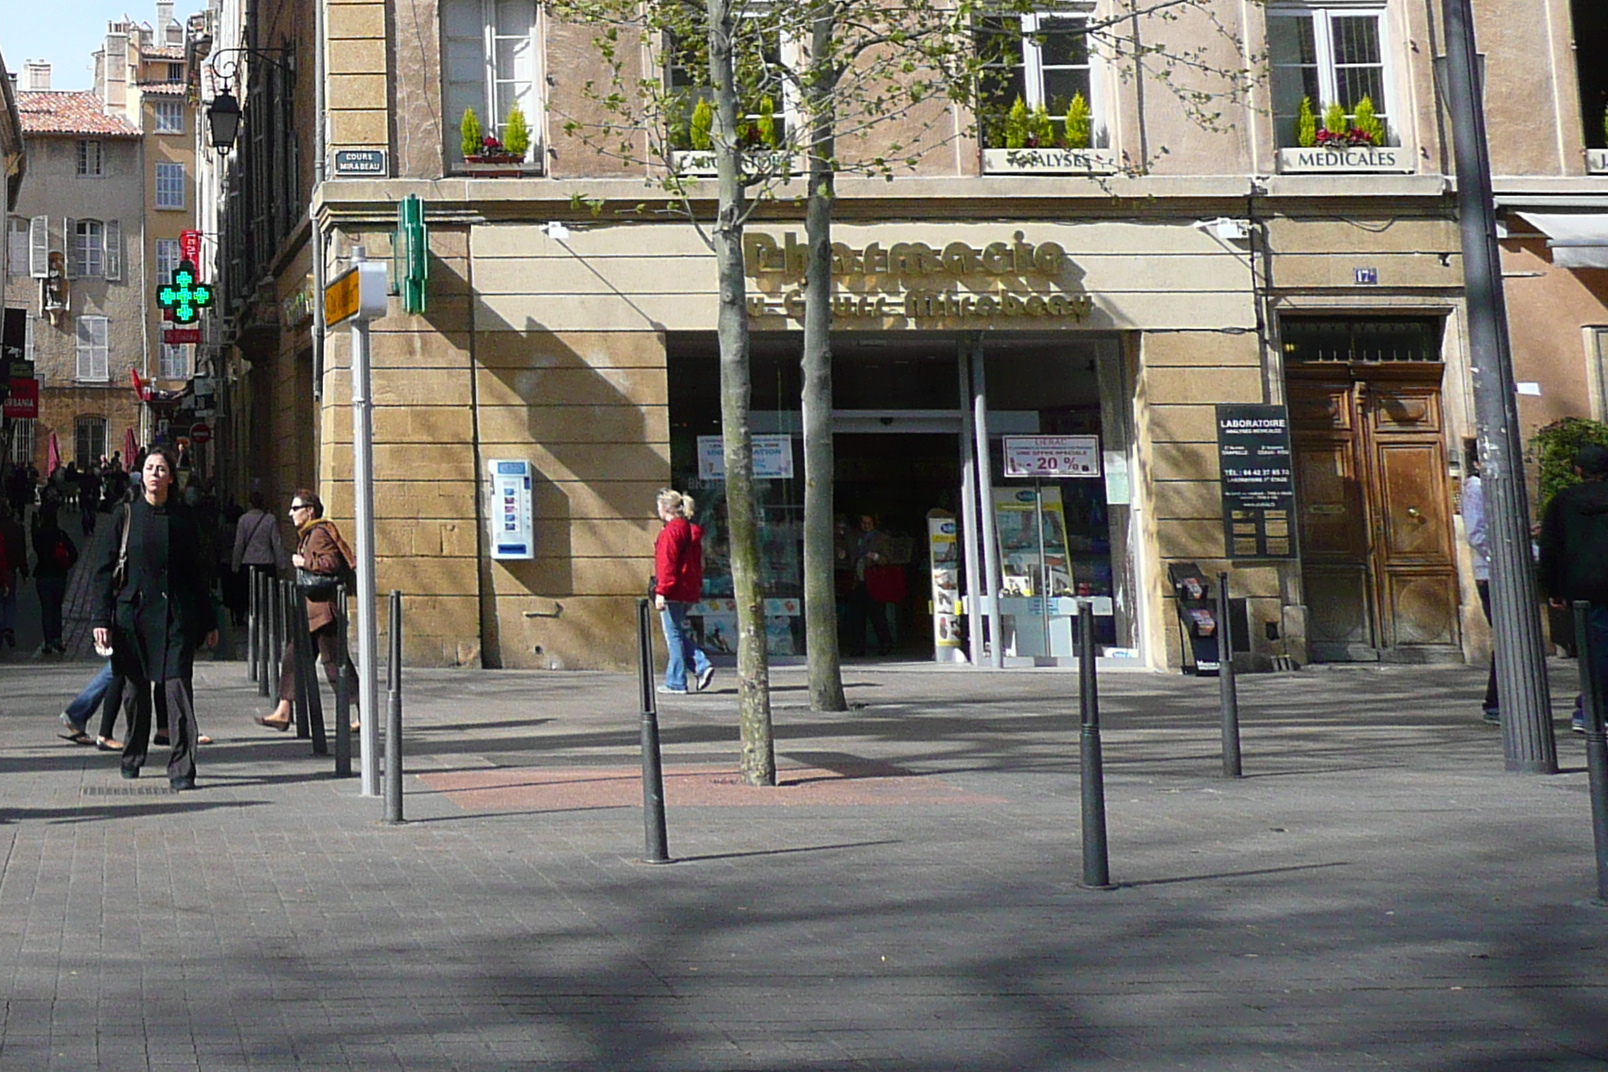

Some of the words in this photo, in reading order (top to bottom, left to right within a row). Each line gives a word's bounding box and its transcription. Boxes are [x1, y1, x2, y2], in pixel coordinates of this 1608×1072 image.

[345, 153, 374, 161] COURS
[1298, 152, 1396, 167] MEDICALES
[783, 288, 889, 318] Curs
[1220, 419, 1286, 428] LABORATOIRE
[1037, 457, 1058, 470] 20
[1063, 457, 1079, 470] %
